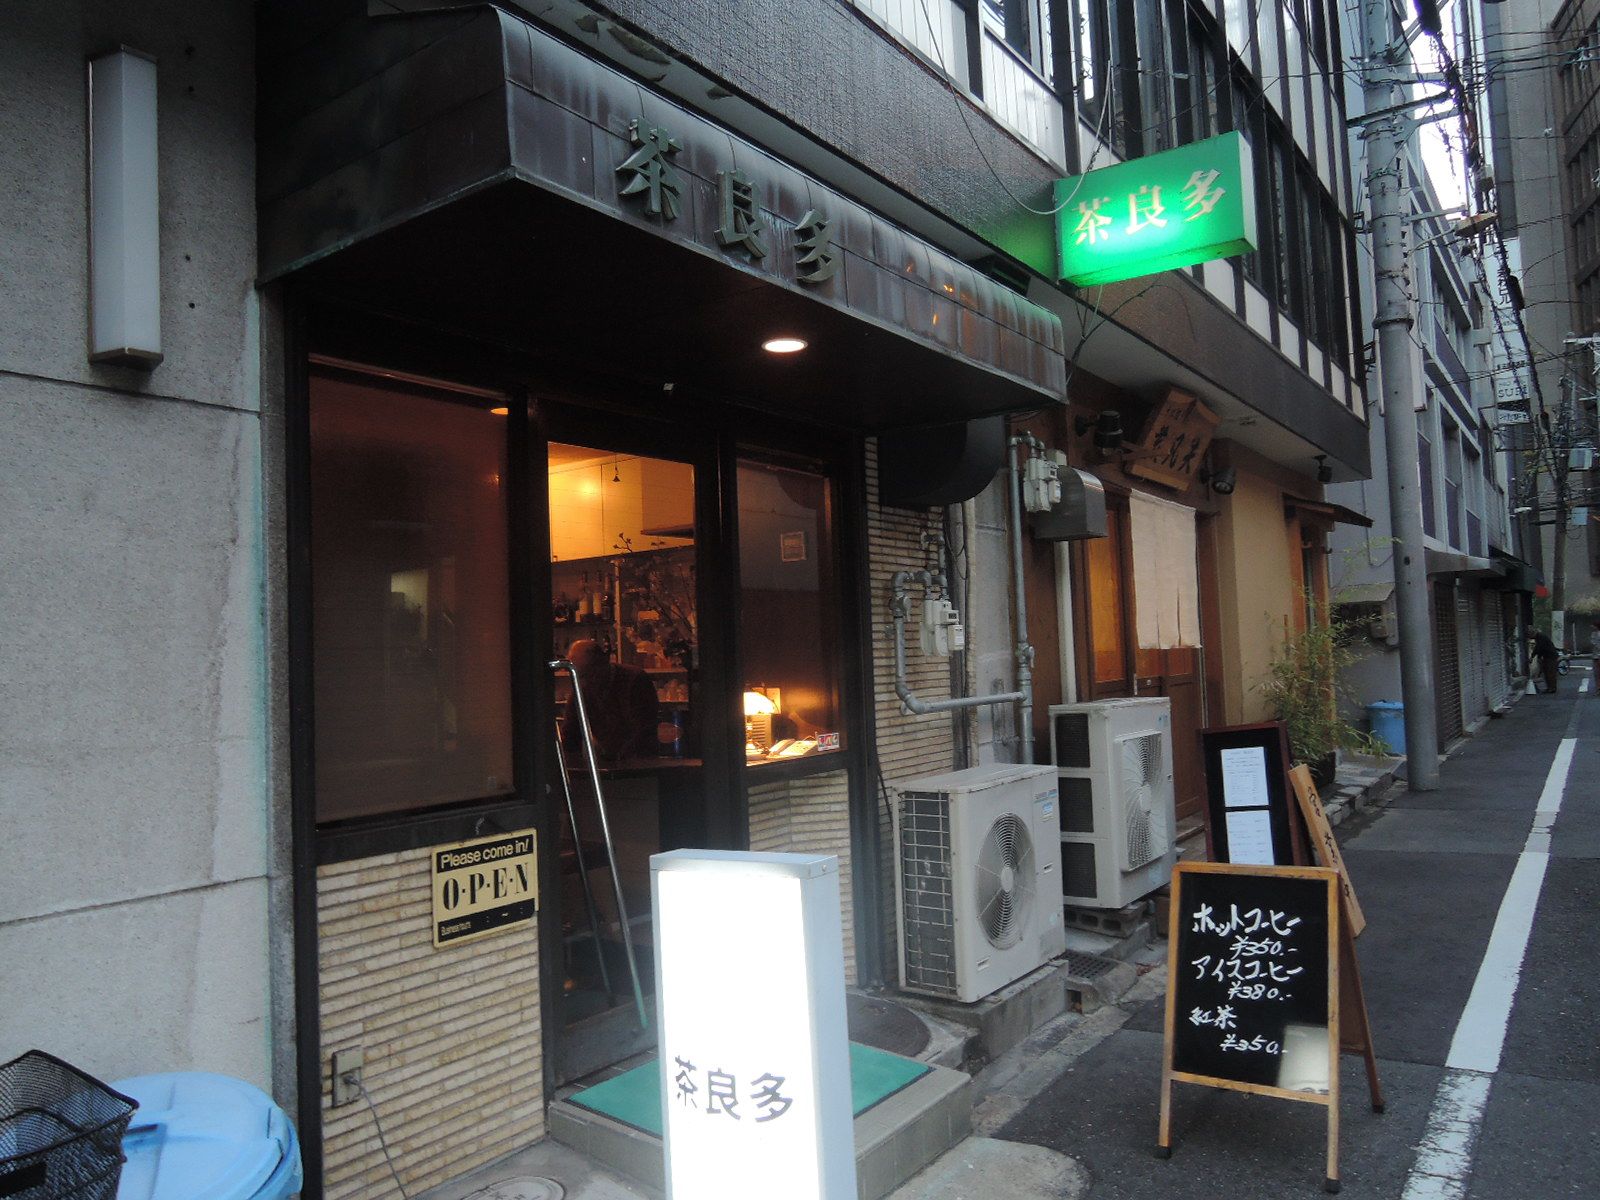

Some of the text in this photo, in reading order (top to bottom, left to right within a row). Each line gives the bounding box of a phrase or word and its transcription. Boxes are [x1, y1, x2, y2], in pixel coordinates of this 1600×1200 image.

[615, 116, 844, 284] 茶良多
[1072, 169, 1226, 245] 茶良多
[441, 838, 530, 869] Please come in!
[1192, 902, 1303, 936] ホットコーヒー
[1191, 955, 1304, 982] アイスコーヒー
[1189, 1004, 1238, 1030] 紅茶
[674, 1055, 794, 1123] 茶良多
